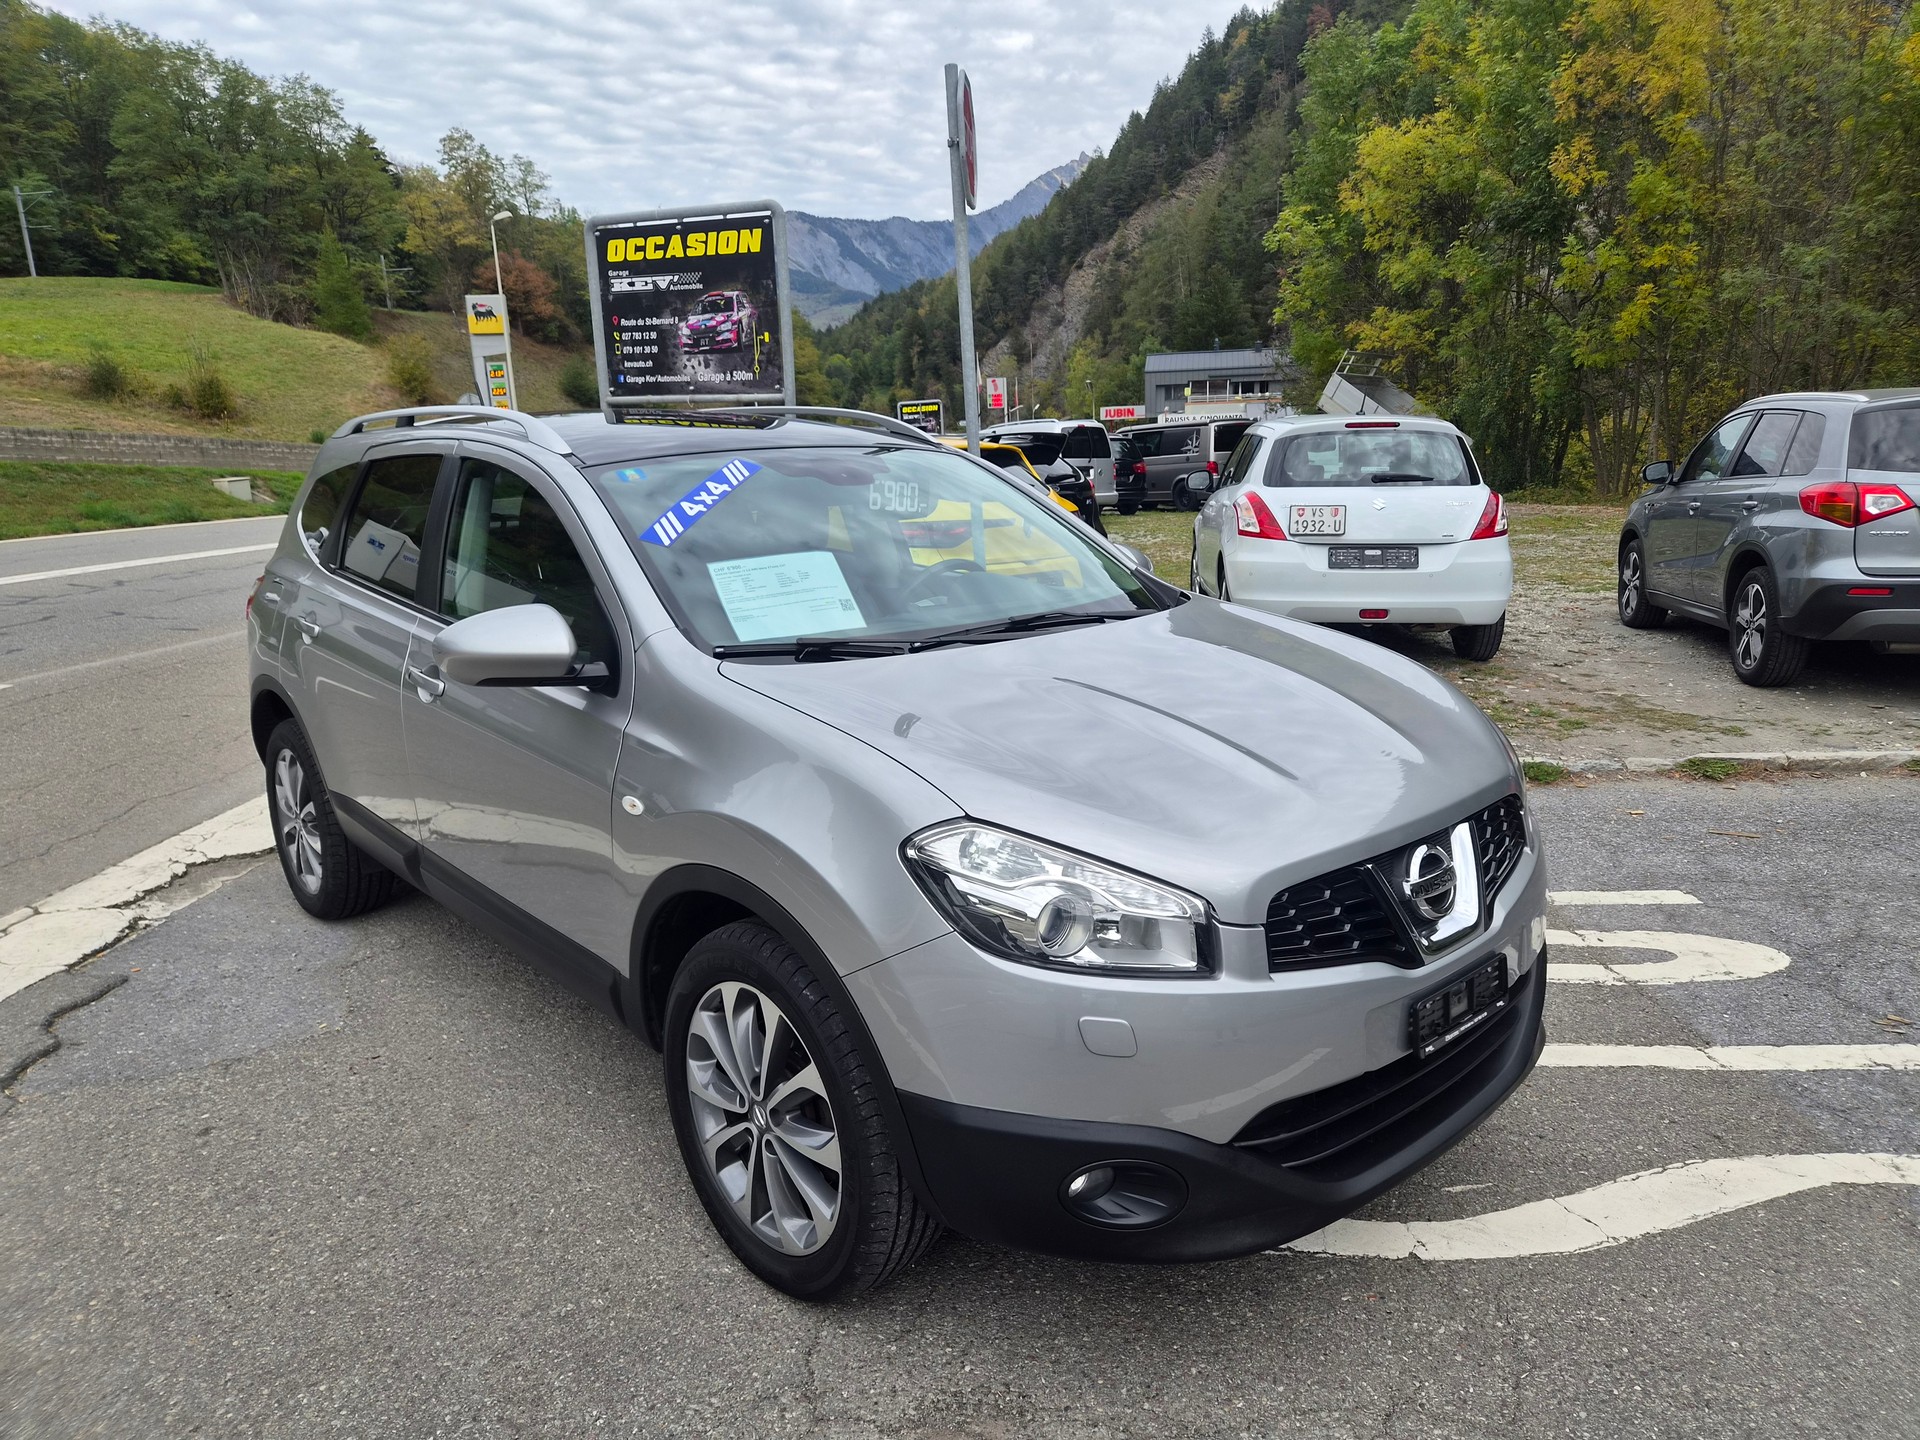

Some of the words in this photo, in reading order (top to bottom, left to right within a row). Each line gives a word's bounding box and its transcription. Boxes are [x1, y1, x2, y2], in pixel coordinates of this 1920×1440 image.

[606, 228, 763, 263] OCCASION
[608, 269, 629, 277] Garage
[620, 318, 637, 327] Route
[637, 318, 645, 326] du
[645, 316, 674, 326] St-Bernard
[621, 332, 632, 340] 027
[632, 332, 642, 340] 783
[643, 332, 650, 340] 12
[650, 331, 658, 339] 50
[622, 346, 633, 354] 079
[634, 346, 643, 354] 101
[643, 346, 651, 354] 30
[651, 345, 659, 353] 50
[624, 360, 654, 368] kevauto.ch
[625, 374, 645, 384] Garage
[697, 371, 724, 384] Garage
[726, 370, 731, 381] à
[732, 370, 753, 381] 500m
[902, 404, 939, 414] OCCASION
[1104, 407, 1135, 419] JUBIN
[679, 477, 732, 517] 4x4
[1311, 507, 1325, 518] VS
